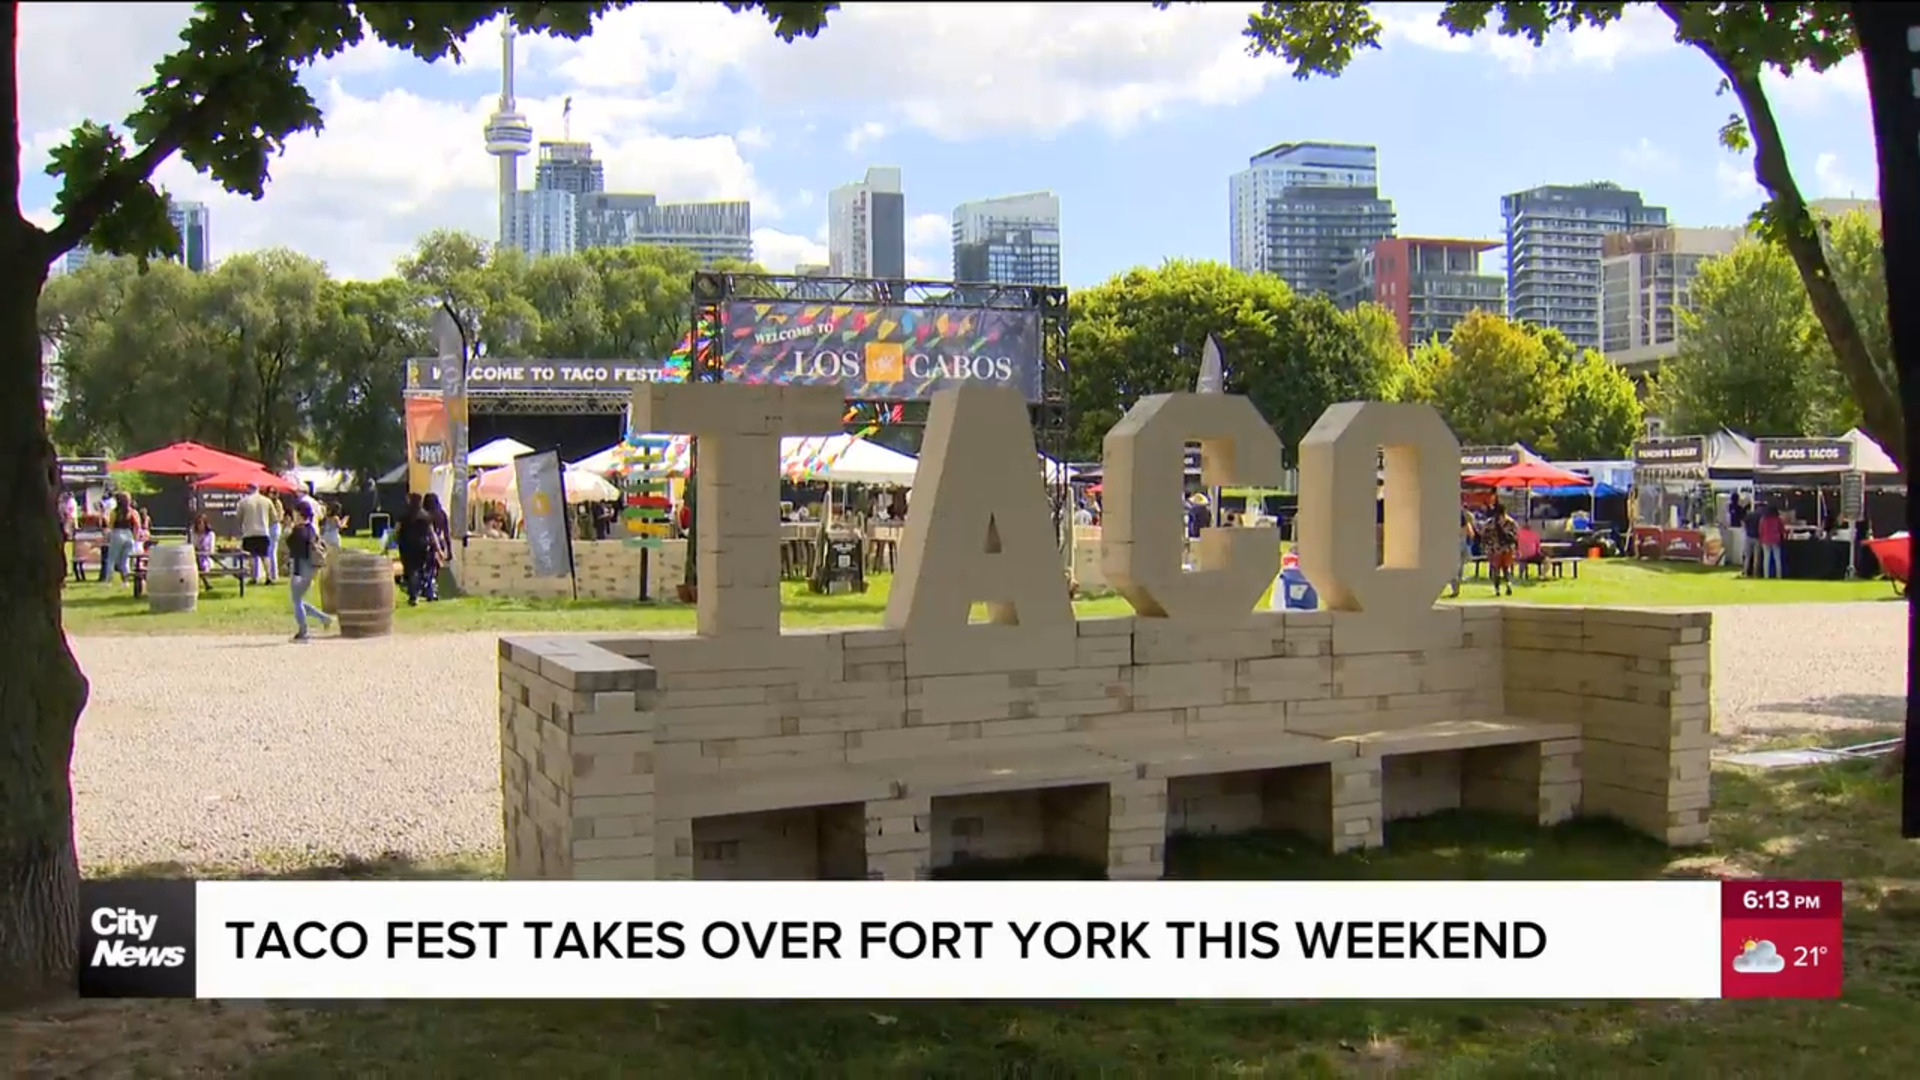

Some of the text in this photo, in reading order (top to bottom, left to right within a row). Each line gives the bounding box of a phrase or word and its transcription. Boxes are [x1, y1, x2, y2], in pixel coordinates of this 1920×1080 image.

[755, 322, 833, 343] WELCOME TO
[433, 366, 524, 381] WCOME
[531, 367, 554, 381] TO
[561, 367, 608, 381] TACO
[793, 350, 1013, 380] LOS CABOS
[1769, 448, 1839, 459] FLACOS TACOS
[632, 383, 1462, 645] TACO
